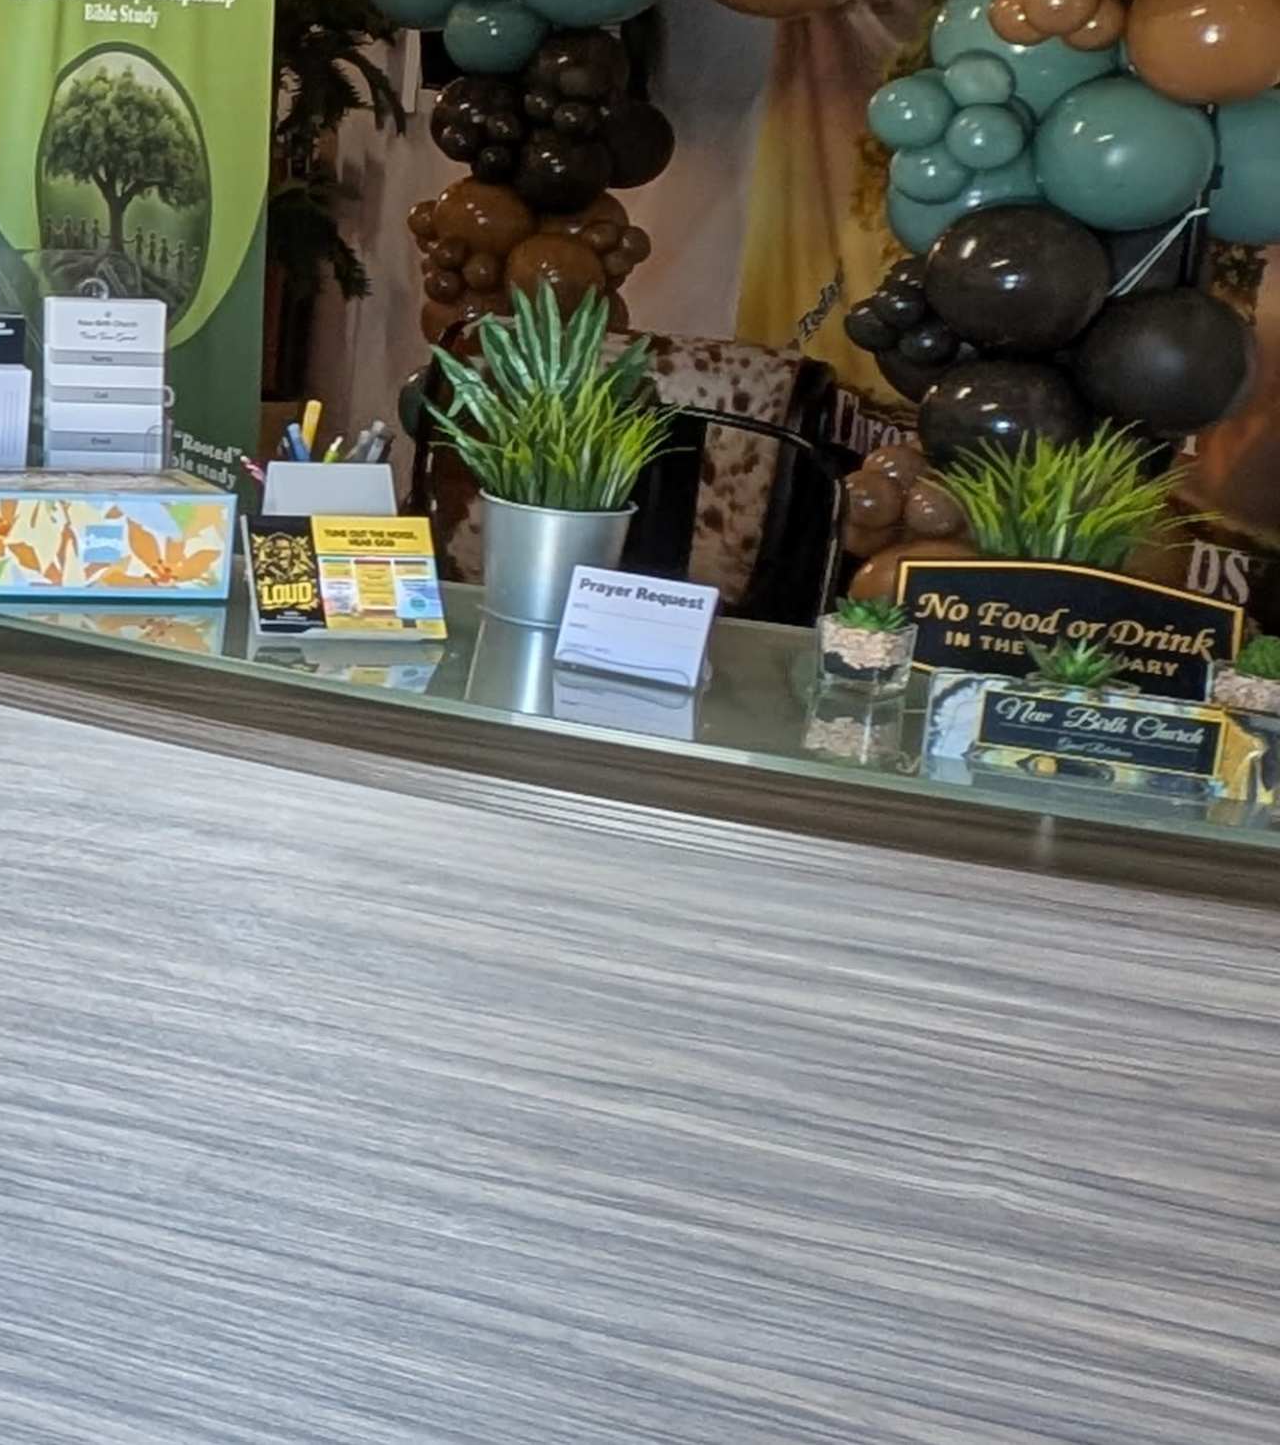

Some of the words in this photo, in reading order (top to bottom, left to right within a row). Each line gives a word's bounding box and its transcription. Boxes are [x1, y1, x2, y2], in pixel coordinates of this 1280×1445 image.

[84, 4, 117, 22] Bible
[119, 5, 159, 29] Study
[262, 582, 313, 604] LOUD
[580, 578, 632, 597] Prayer
[636, 588, 705, 610] Request
[915, 592, 970, 622] No
[977, 602, 1070, 636] Food
[1066, 619, 1107, 640] or
[1107, 620, 1216, 660] Drink
[945, 631, 971, 648] IN
[980, 635, 1025, 655] THE
[1132, 715, 1206, 745] Church
